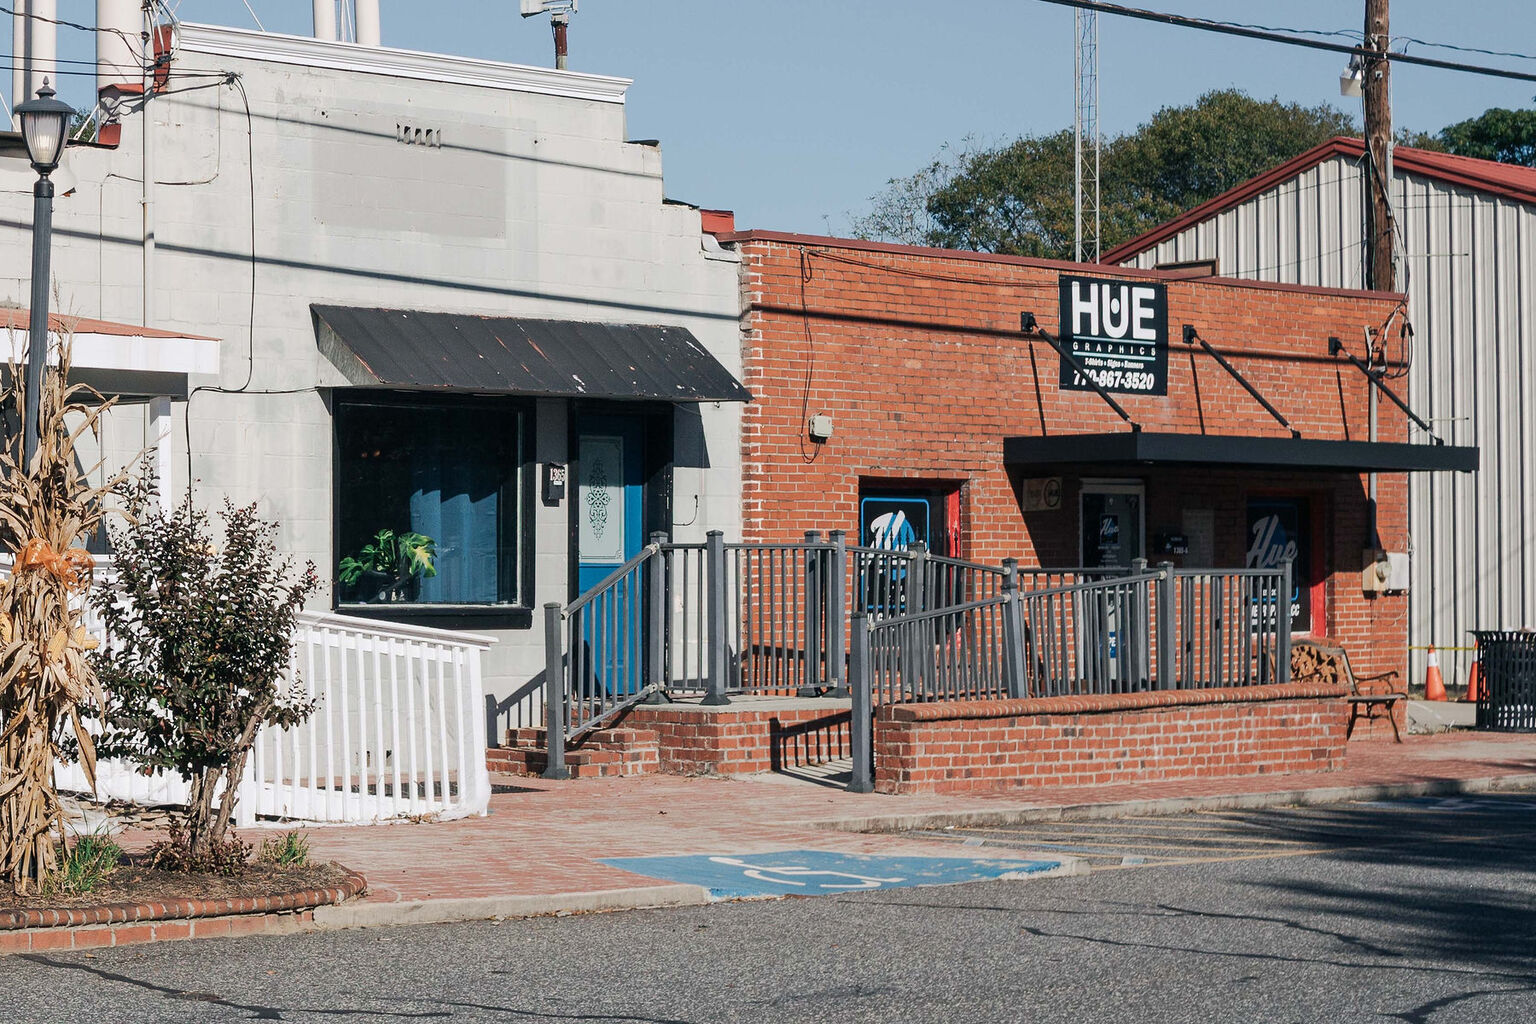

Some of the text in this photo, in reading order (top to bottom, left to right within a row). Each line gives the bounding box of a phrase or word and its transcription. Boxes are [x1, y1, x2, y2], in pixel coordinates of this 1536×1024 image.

[1072, 281, 1156, 340] HUE
[1072, 341, 1156, 356] GRAPHICS
[1246, 514, 1298, 569] Hue
